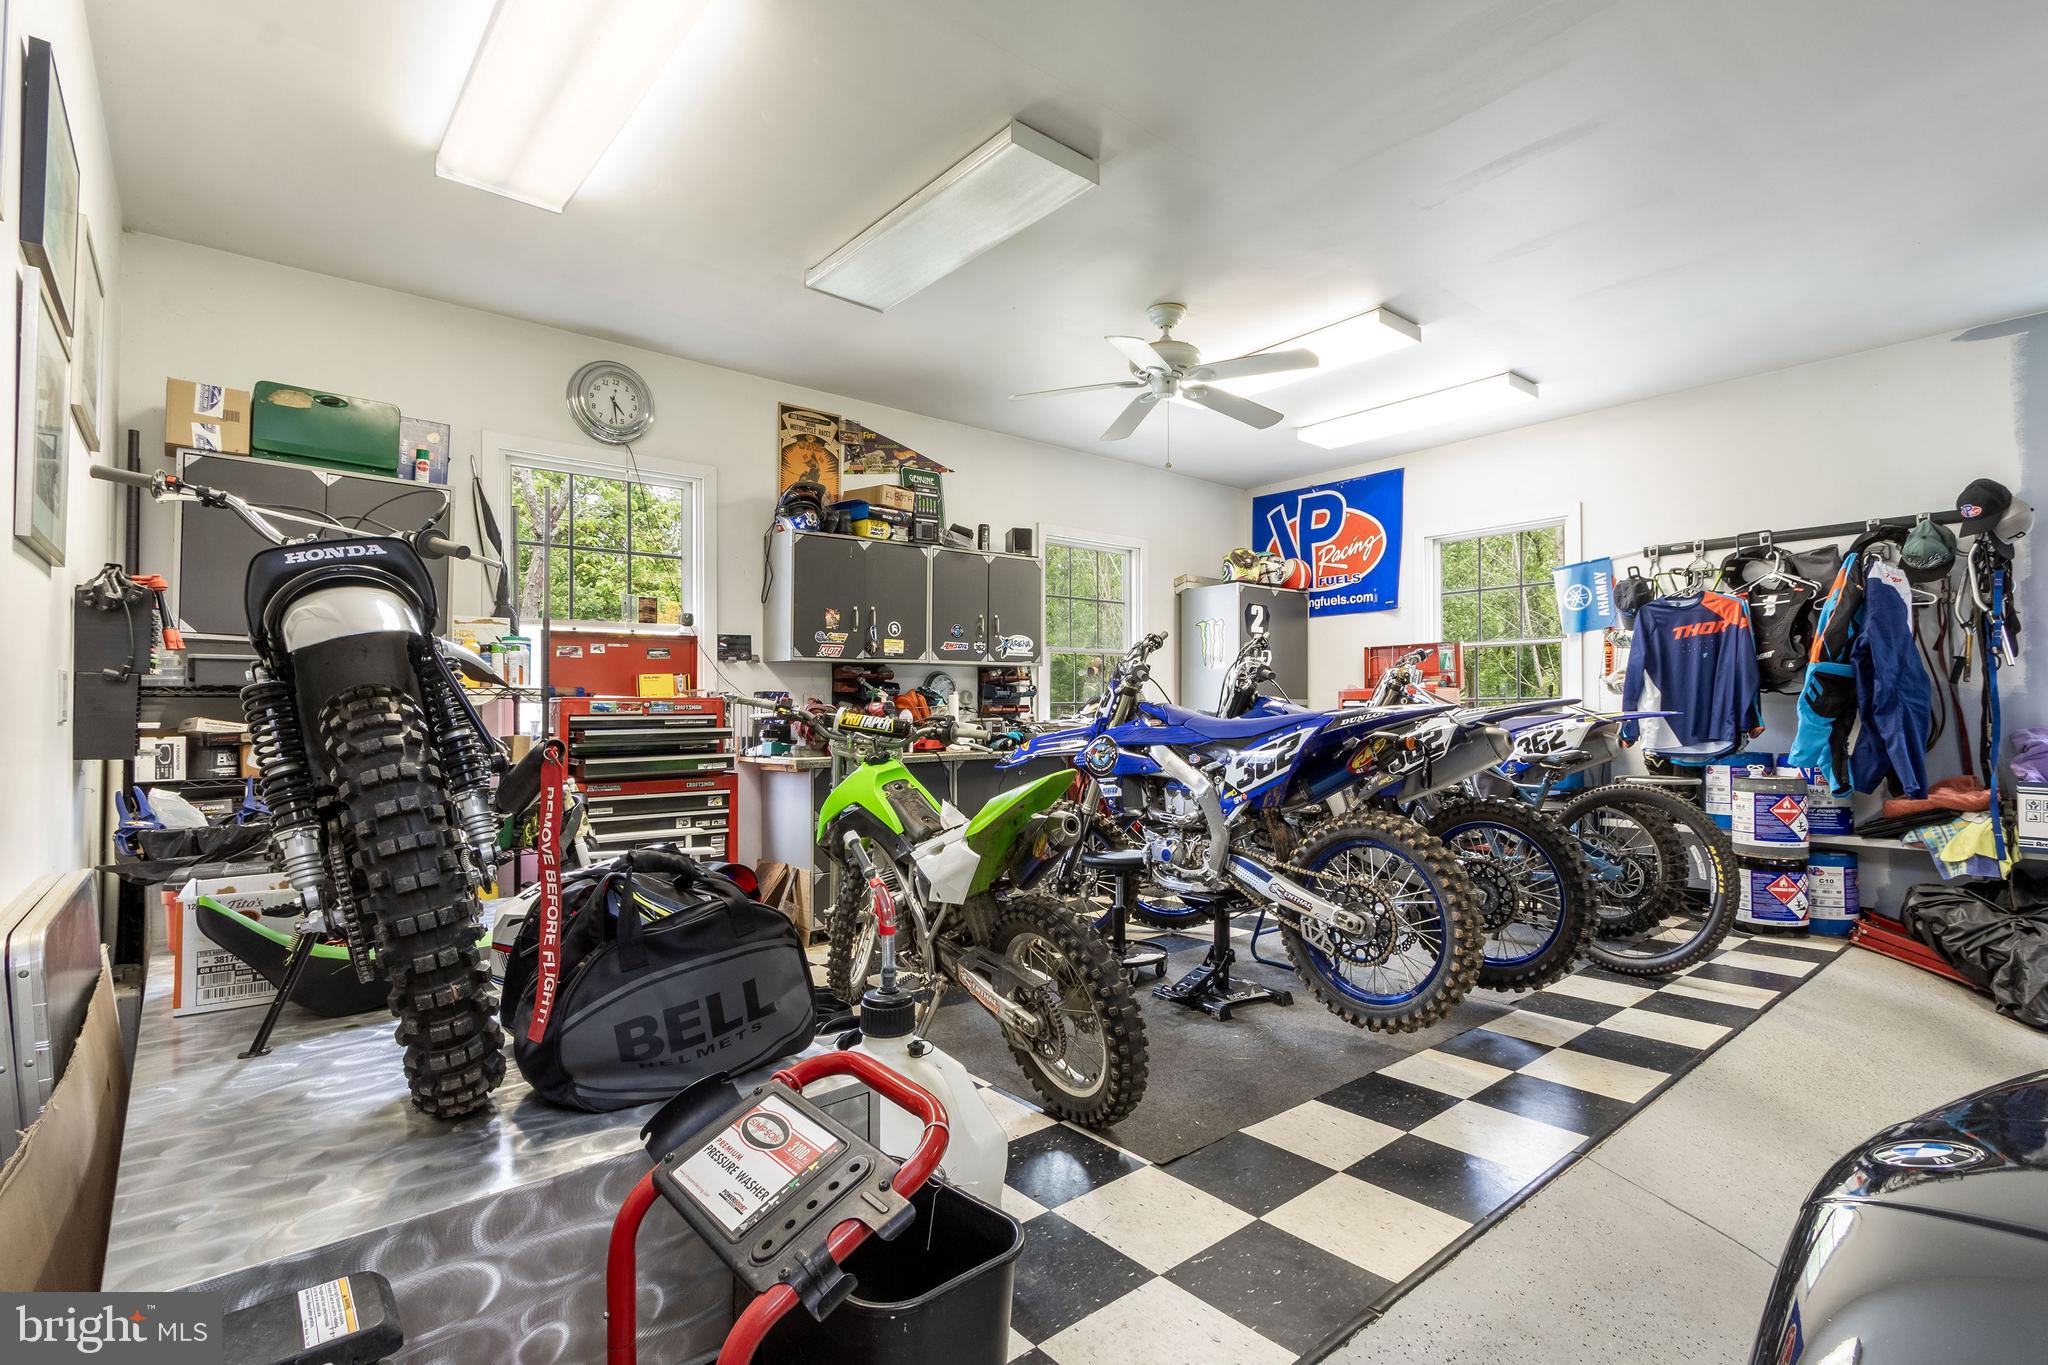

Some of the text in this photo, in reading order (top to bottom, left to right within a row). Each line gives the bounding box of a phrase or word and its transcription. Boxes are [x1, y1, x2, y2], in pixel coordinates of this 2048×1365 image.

[863, 431, 876, 440] Fire
[908, 474, 936, 486] GENUINE
[284, 544, 388, 564] HONDA
[1318, 534, 1382, 577] Racing
[1318, 572, 1364, 588] FUELS
[1309, 592, 1375, 610] ngfuels.com
[1250, 604, 1264, 633] 2
[1672, 620, 1729, 641] THOR
[821, 646, 842, 654] KLOTZ
[227, 897, 262, 909] Tito's
[537, 786, 558, 1024] REMOVE BEFORE FLIGHT!
[614, 978, 777, 1063] BELL
[639, 1022, 763, 1069] HELMETS
[749, 1118, 782, 1143] SIMPSON
[715, 1137, 744, 1162] PREMIUM
[787, 1141, 811, 1160] 3100
[703, 1144, 740, 1176] PRESSURE
[735, 1169, 770, 1202] WASHER
